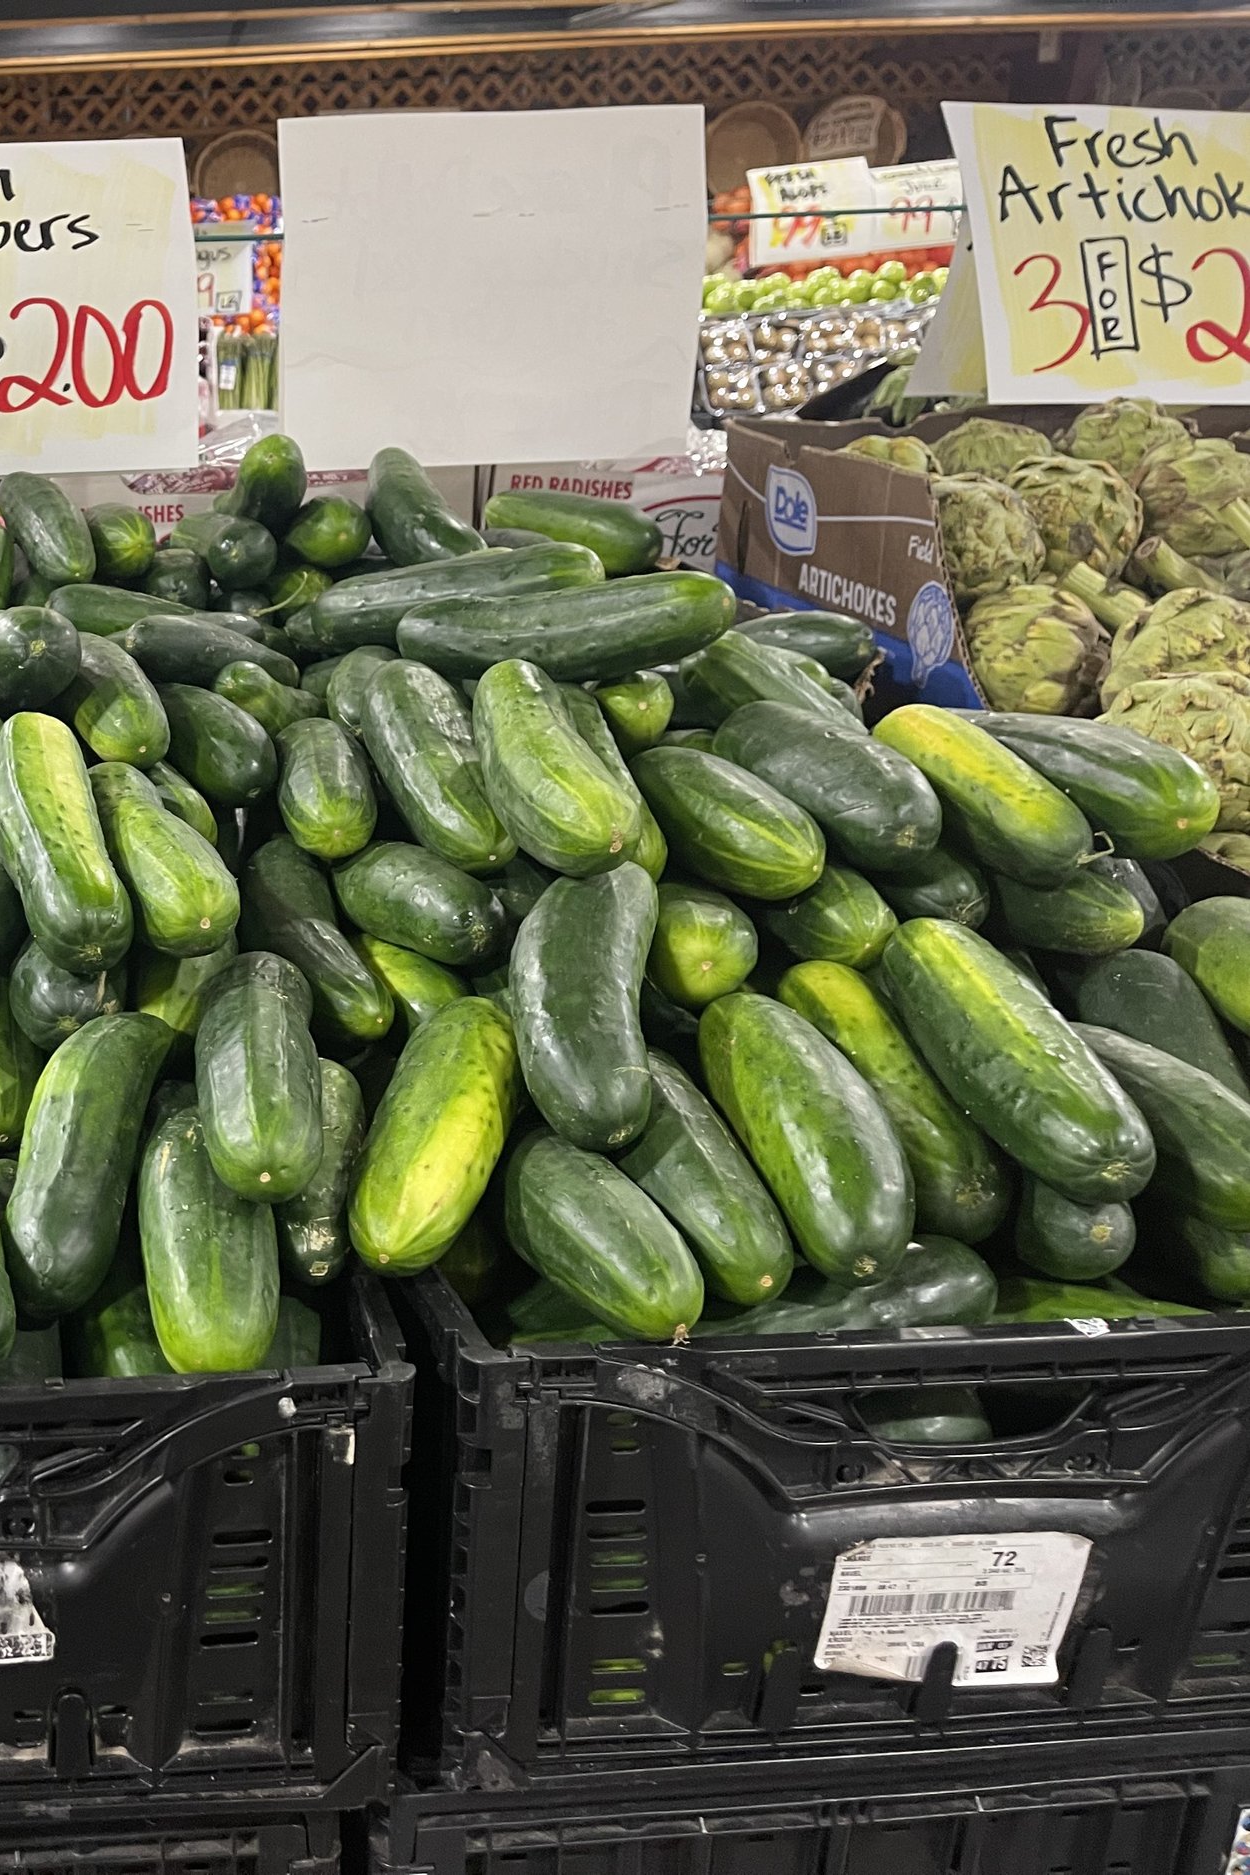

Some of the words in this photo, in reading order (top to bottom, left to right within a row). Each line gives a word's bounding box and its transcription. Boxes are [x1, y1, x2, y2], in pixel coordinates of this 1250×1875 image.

[1044, 115, 1198, 168] Fresh
[998, 164, 1250, 224] Artichok
[1013, 254, 1090, 373] 3
[1096, 251, 1123, 342] FOR
[549, 477, 634, 499] RADISHES
[774, 486, 808, 522] Dole
[138, 504, 184, 523] SHES
[908, 535, 936, 563] Field
[799, 563, 897, 627] ARTICHOKES
[992, 1551, 1017, 1566] 72
